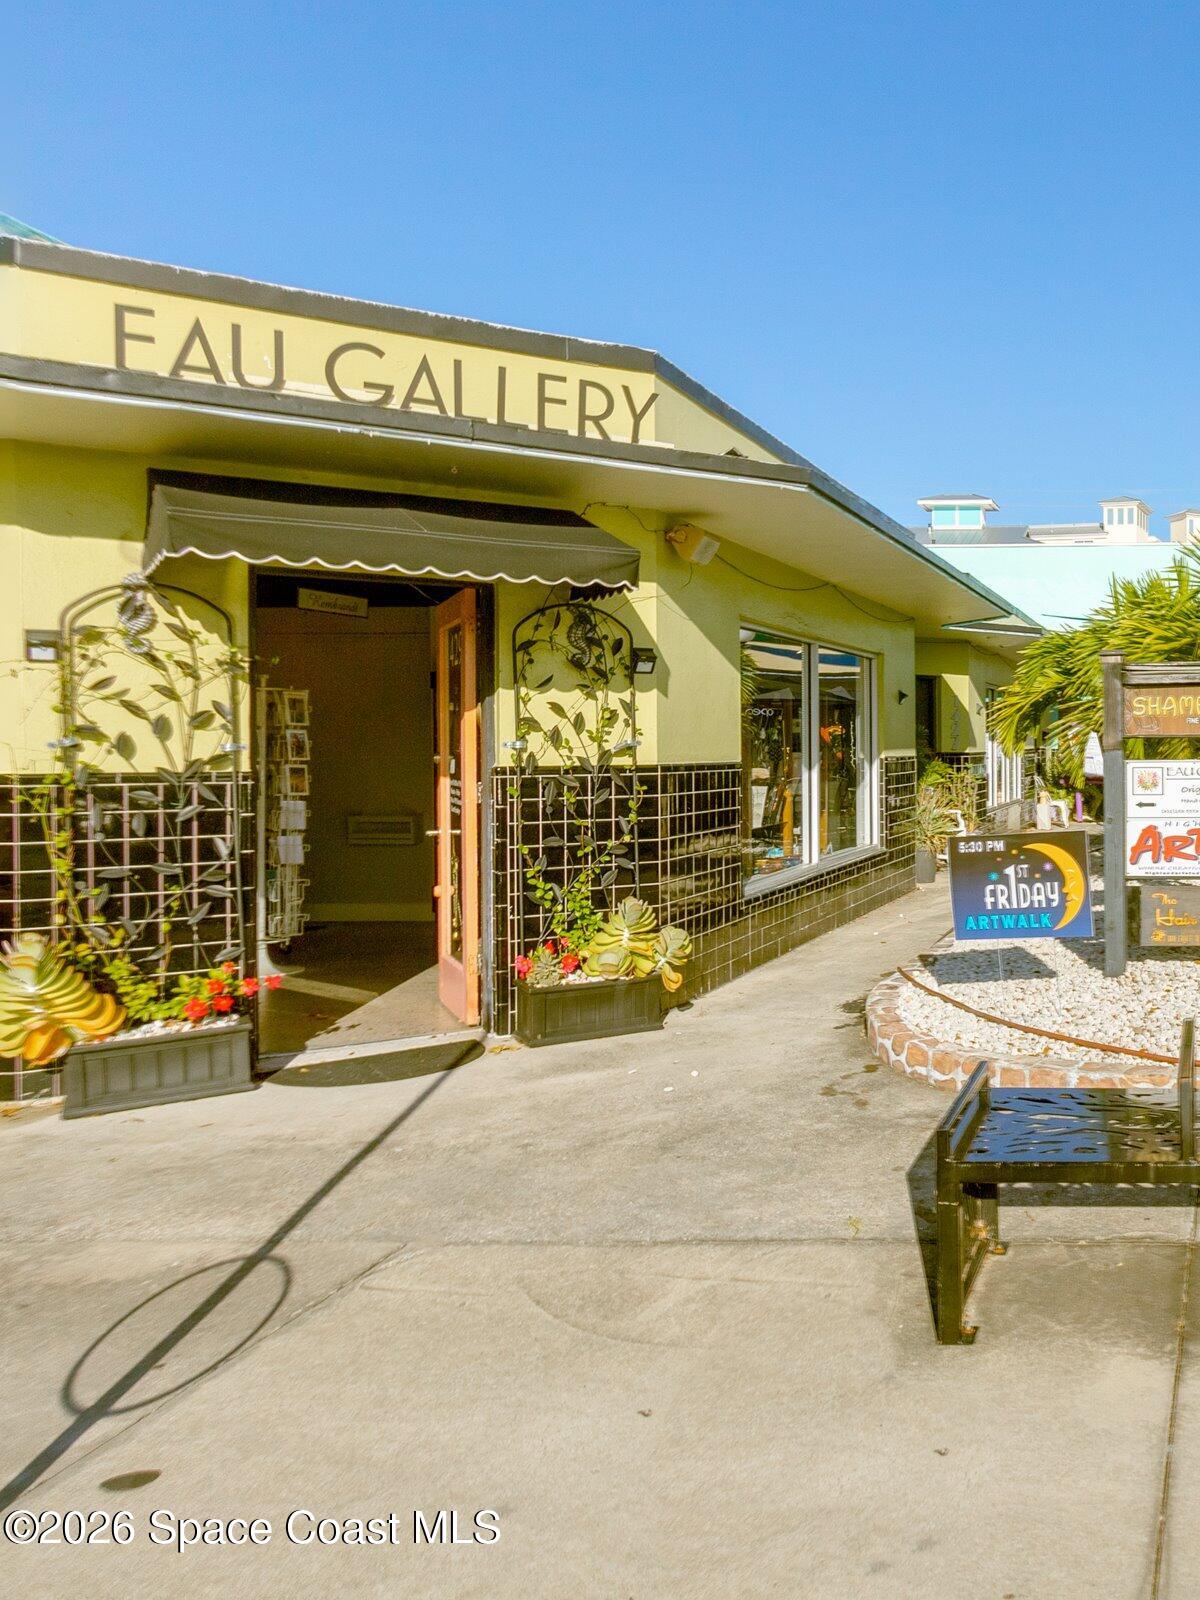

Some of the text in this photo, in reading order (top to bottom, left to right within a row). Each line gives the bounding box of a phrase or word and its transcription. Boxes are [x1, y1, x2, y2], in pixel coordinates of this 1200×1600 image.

[115, 304, 660, 445] EAU GALLERY
[1166, 766, 1194, 777] EAU
[985, 840, 1005, 852] PM
[1151, 893, 1177, 905] The
[965, 913, 1052, 931] ARTWALK
[1155, 908, 1197, 926] Hair
